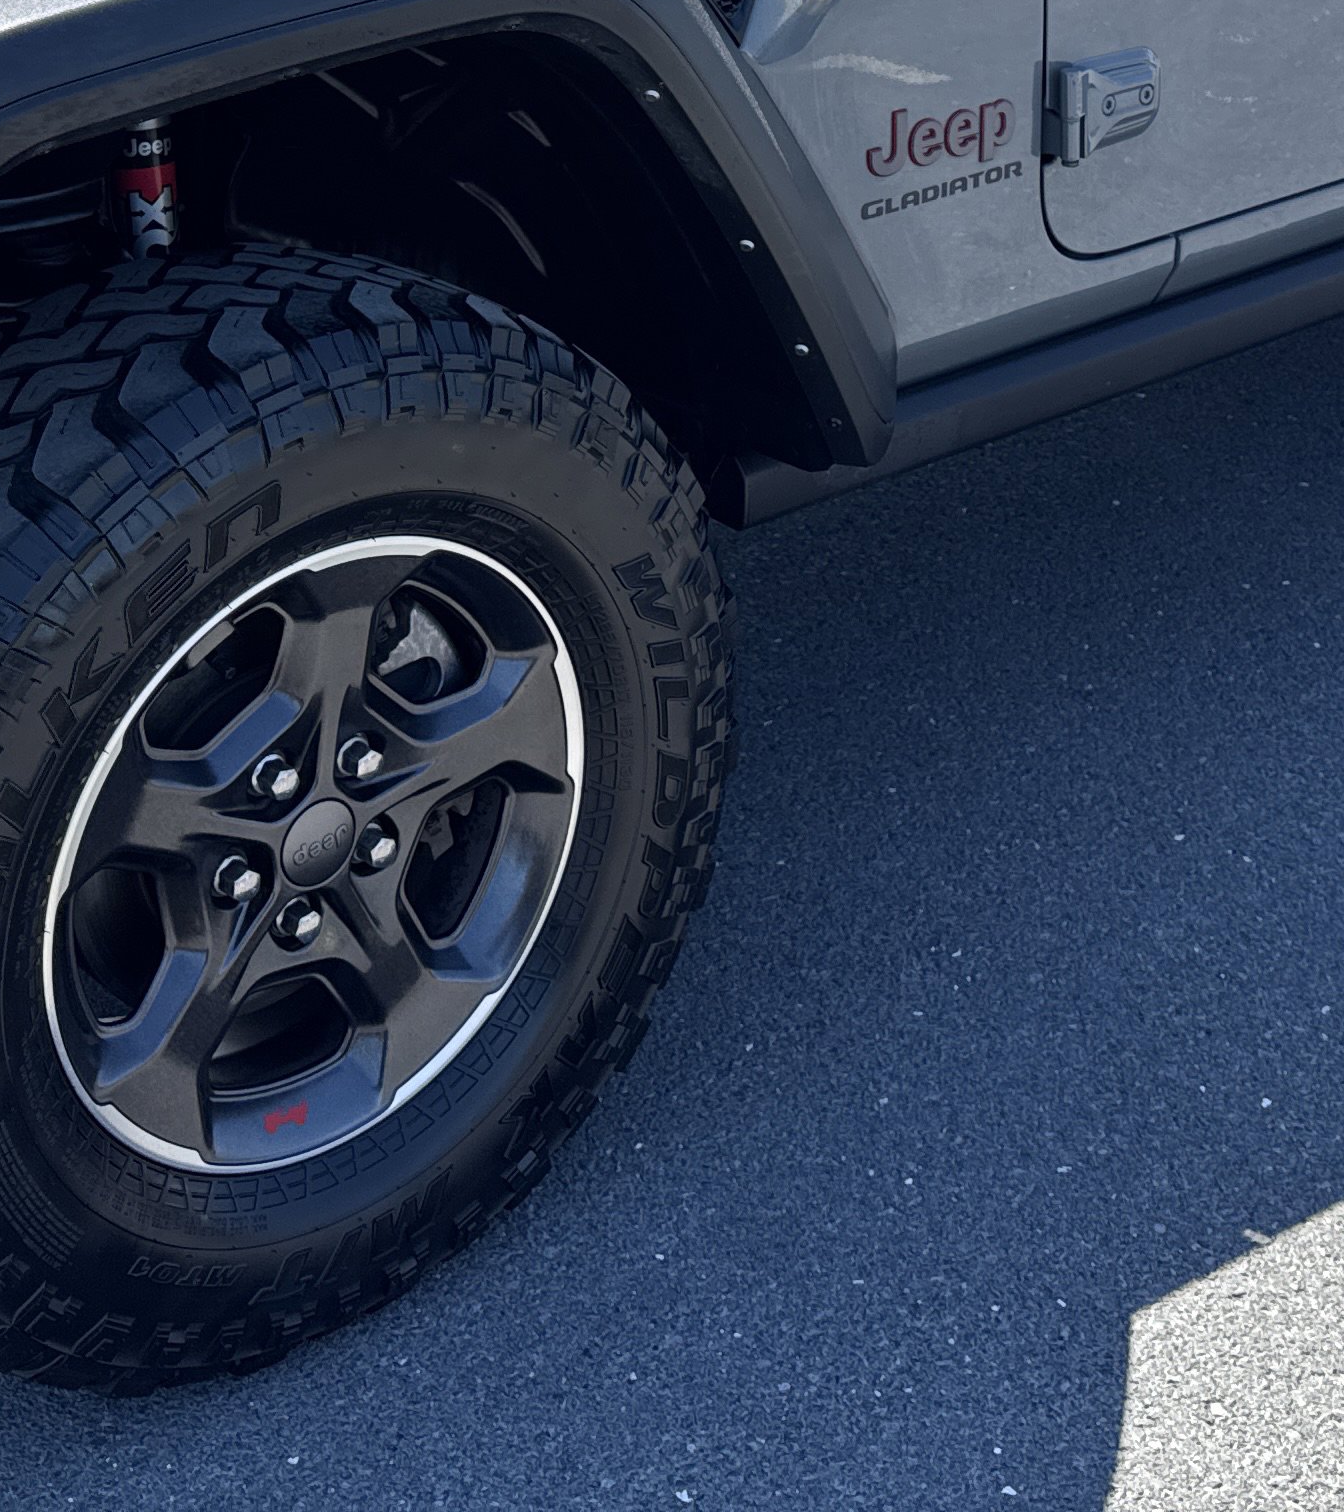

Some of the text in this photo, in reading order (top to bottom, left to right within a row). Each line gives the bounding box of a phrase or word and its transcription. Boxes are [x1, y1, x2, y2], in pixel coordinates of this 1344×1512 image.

[123, 138, 172, 158] Jeep
[865, 97, 1017, 178] Jeep
[860, 160, 1024, 221] GLADIATOR
[292, 824, 349, 866] Jeep
[126, 1253, 248, 1289] MT01
